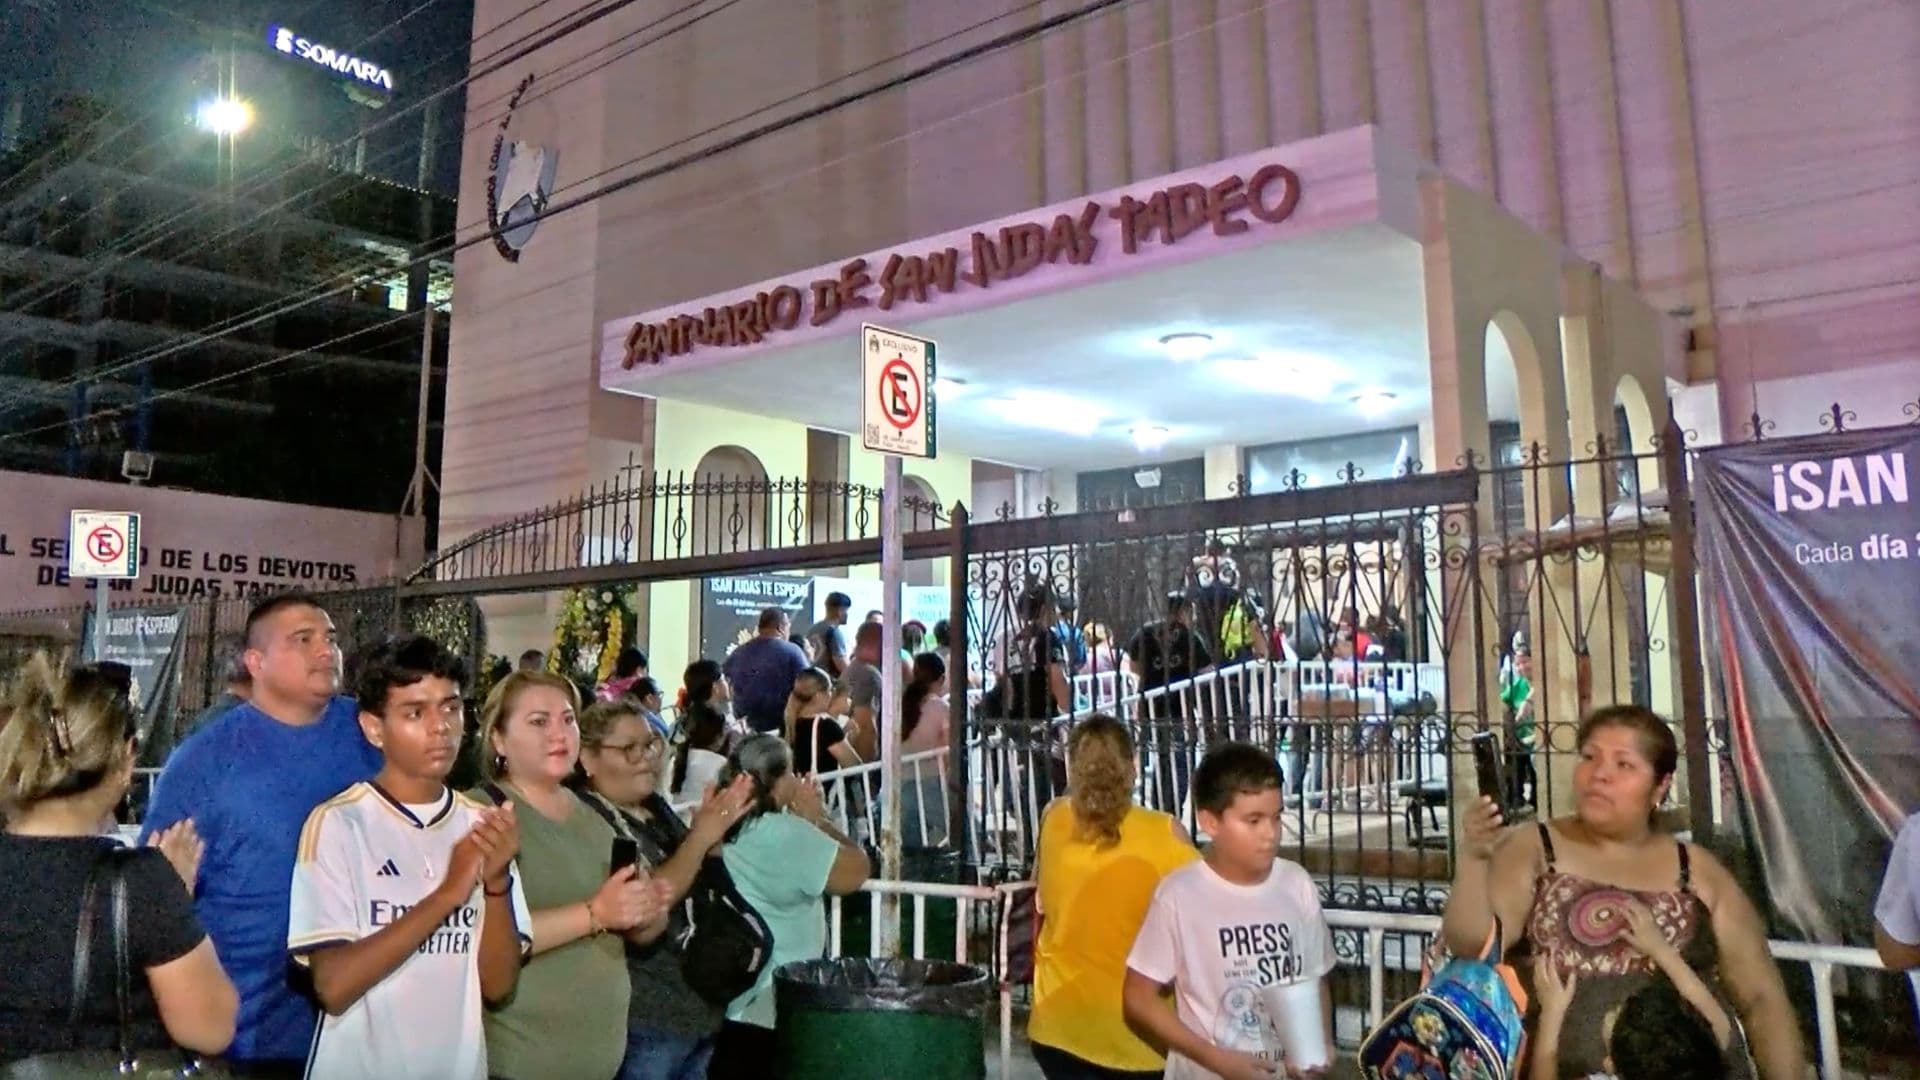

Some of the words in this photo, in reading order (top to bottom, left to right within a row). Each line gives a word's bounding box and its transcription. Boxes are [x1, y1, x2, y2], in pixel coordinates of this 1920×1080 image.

[295, 38, 393, 89] SOMARA
[621, 285, 802, 370] SANTUARIO
[810, 258, 872, 327] DE
[878, 247, 959, 311] SAN
[959, 201, 1101, 288] JUDAS
[1109, 164, 1300, 254] TADEO
[1771, 452, 1909, 513] ¡SAN
[160, 549, 192, 569] DE
[203, 552, 248, 573] LOS
[258, 557, 356, 582] DEVOTOS
[1795, 541, 1854, 566] Cada
[1860, 533, 1908, 560] día
[37, 565, 70, 587] DE
[143, 574, 222, 600] JUDAS
[734, 579, 761, 595] JUDAS
[761, 580, 773, 596] TE
[1218, 923, 1291, 958] PRESS
